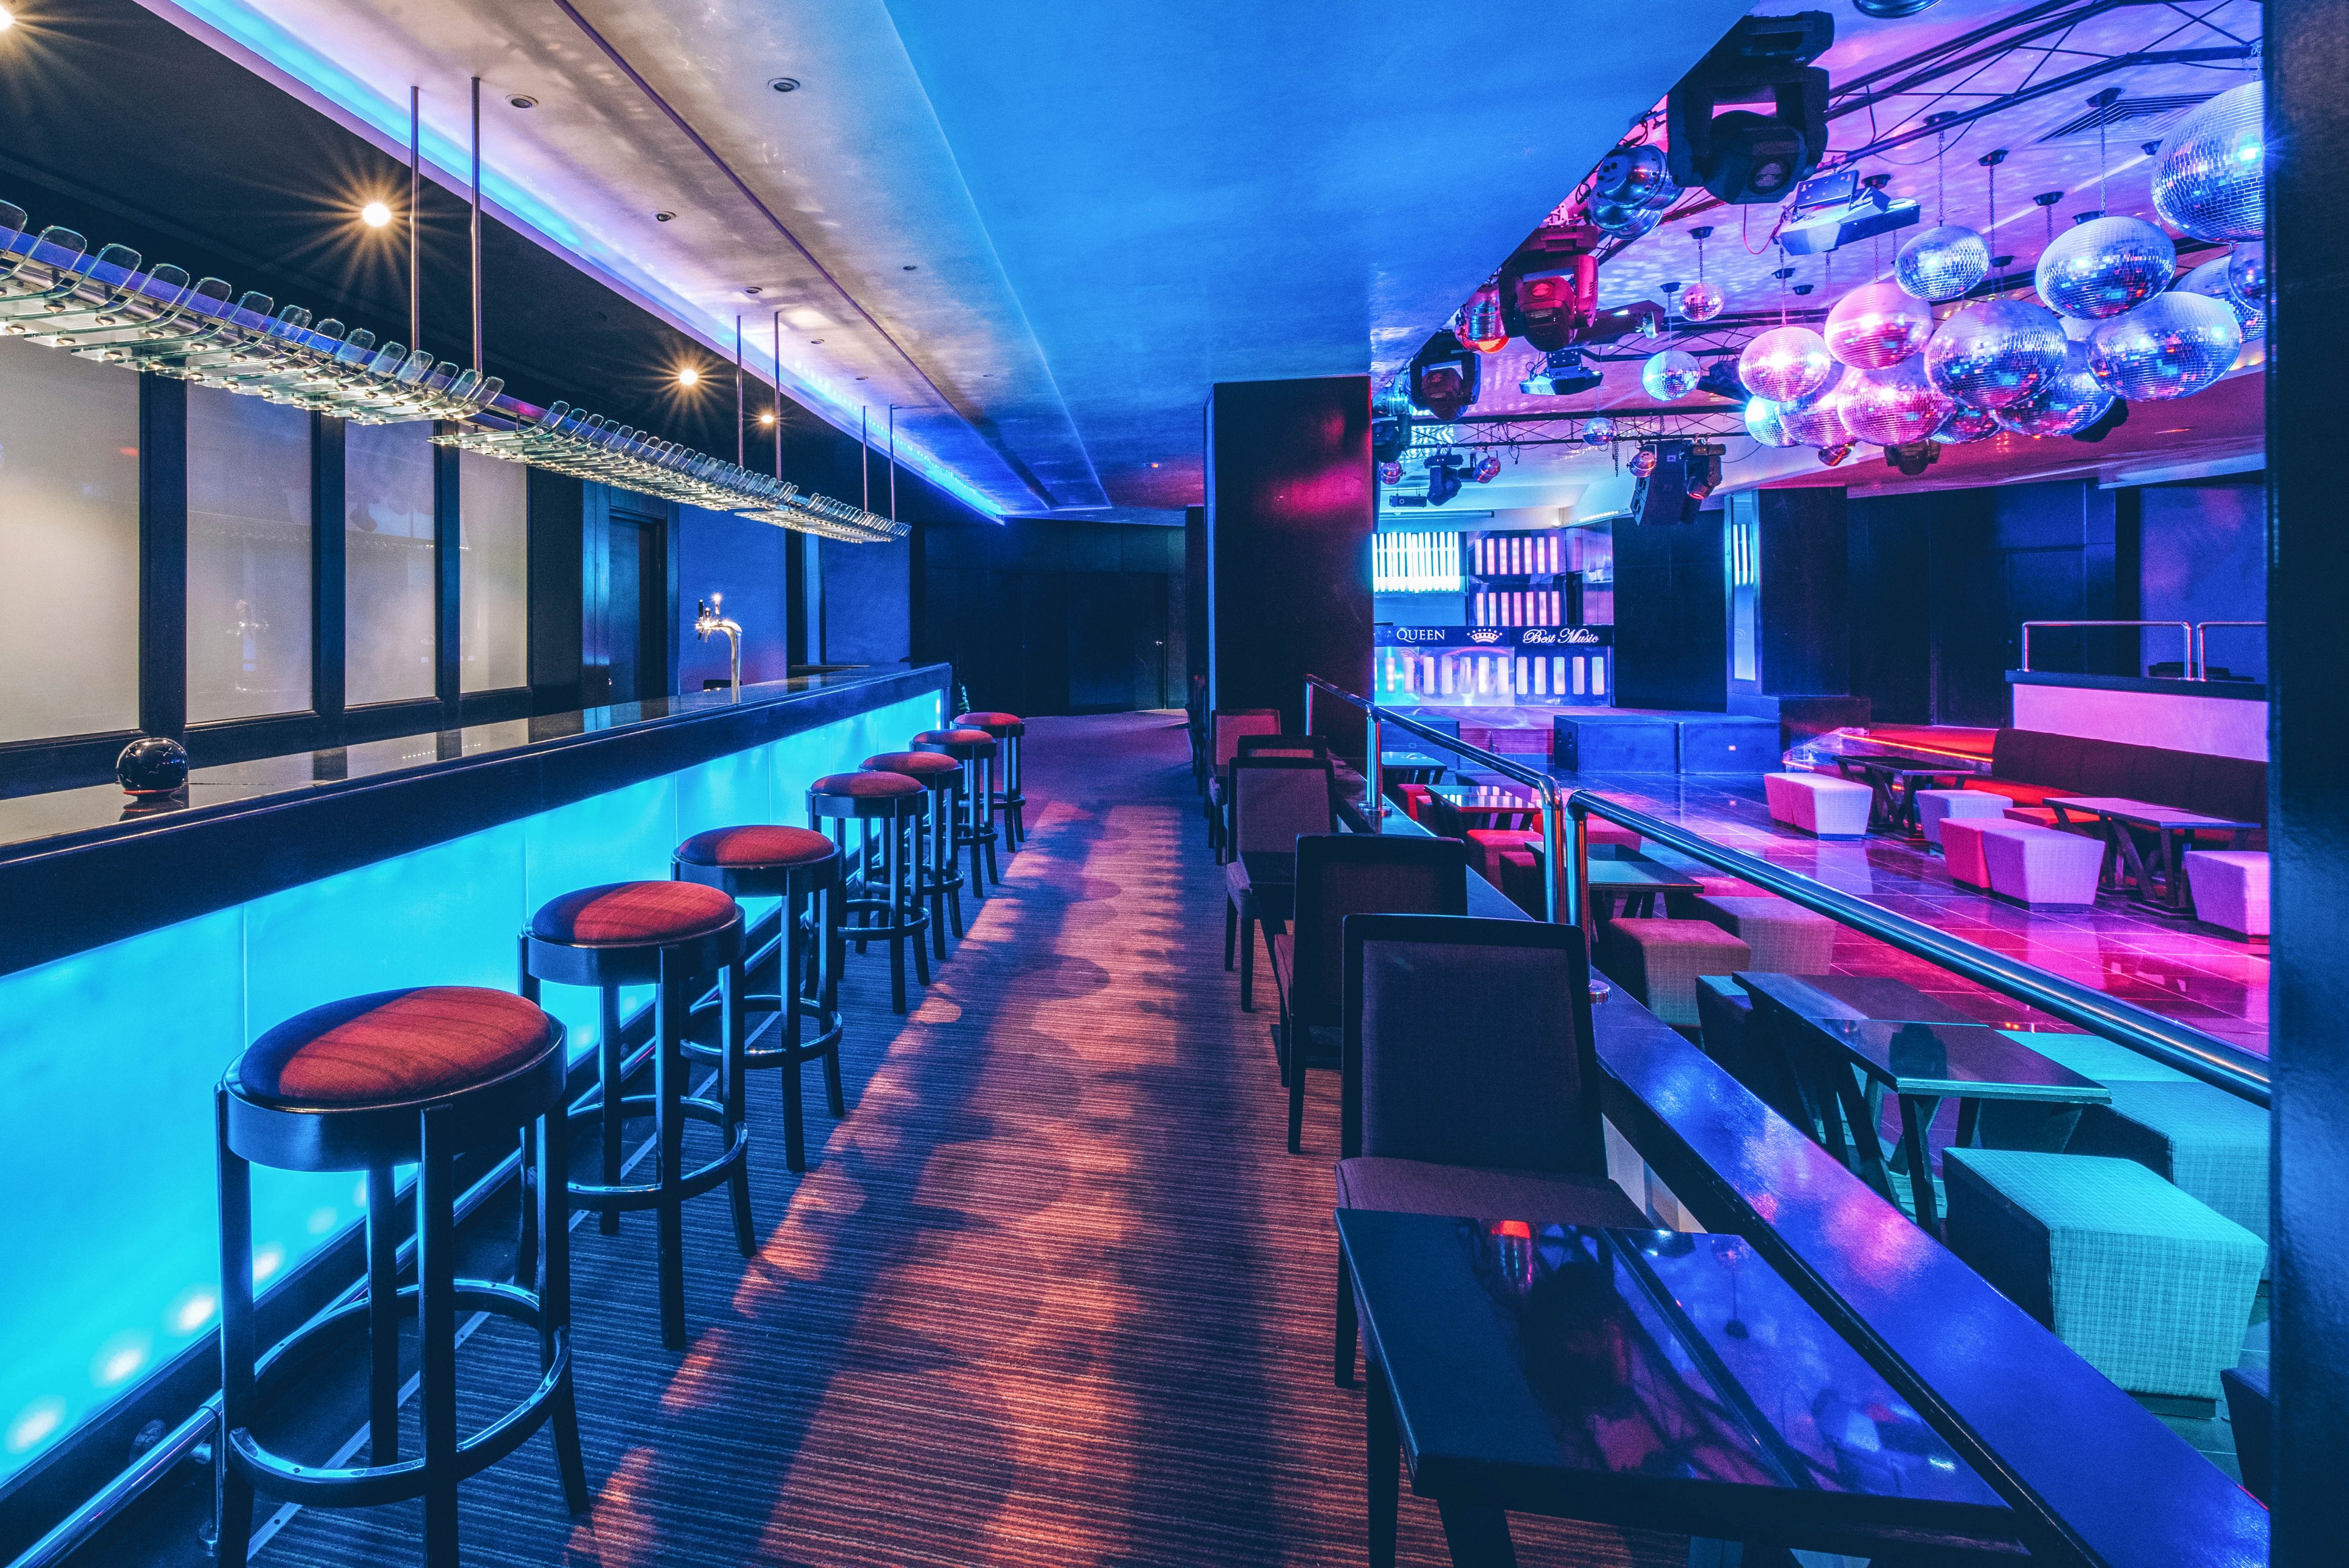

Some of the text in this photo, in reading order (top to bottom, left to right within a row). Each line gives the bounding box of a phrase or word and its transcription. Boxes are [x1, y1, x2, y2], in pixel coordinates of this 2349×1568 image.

[1397, 629, 1445, 642] QUEEN
[1523, 628, 1599, 643] Best Music
